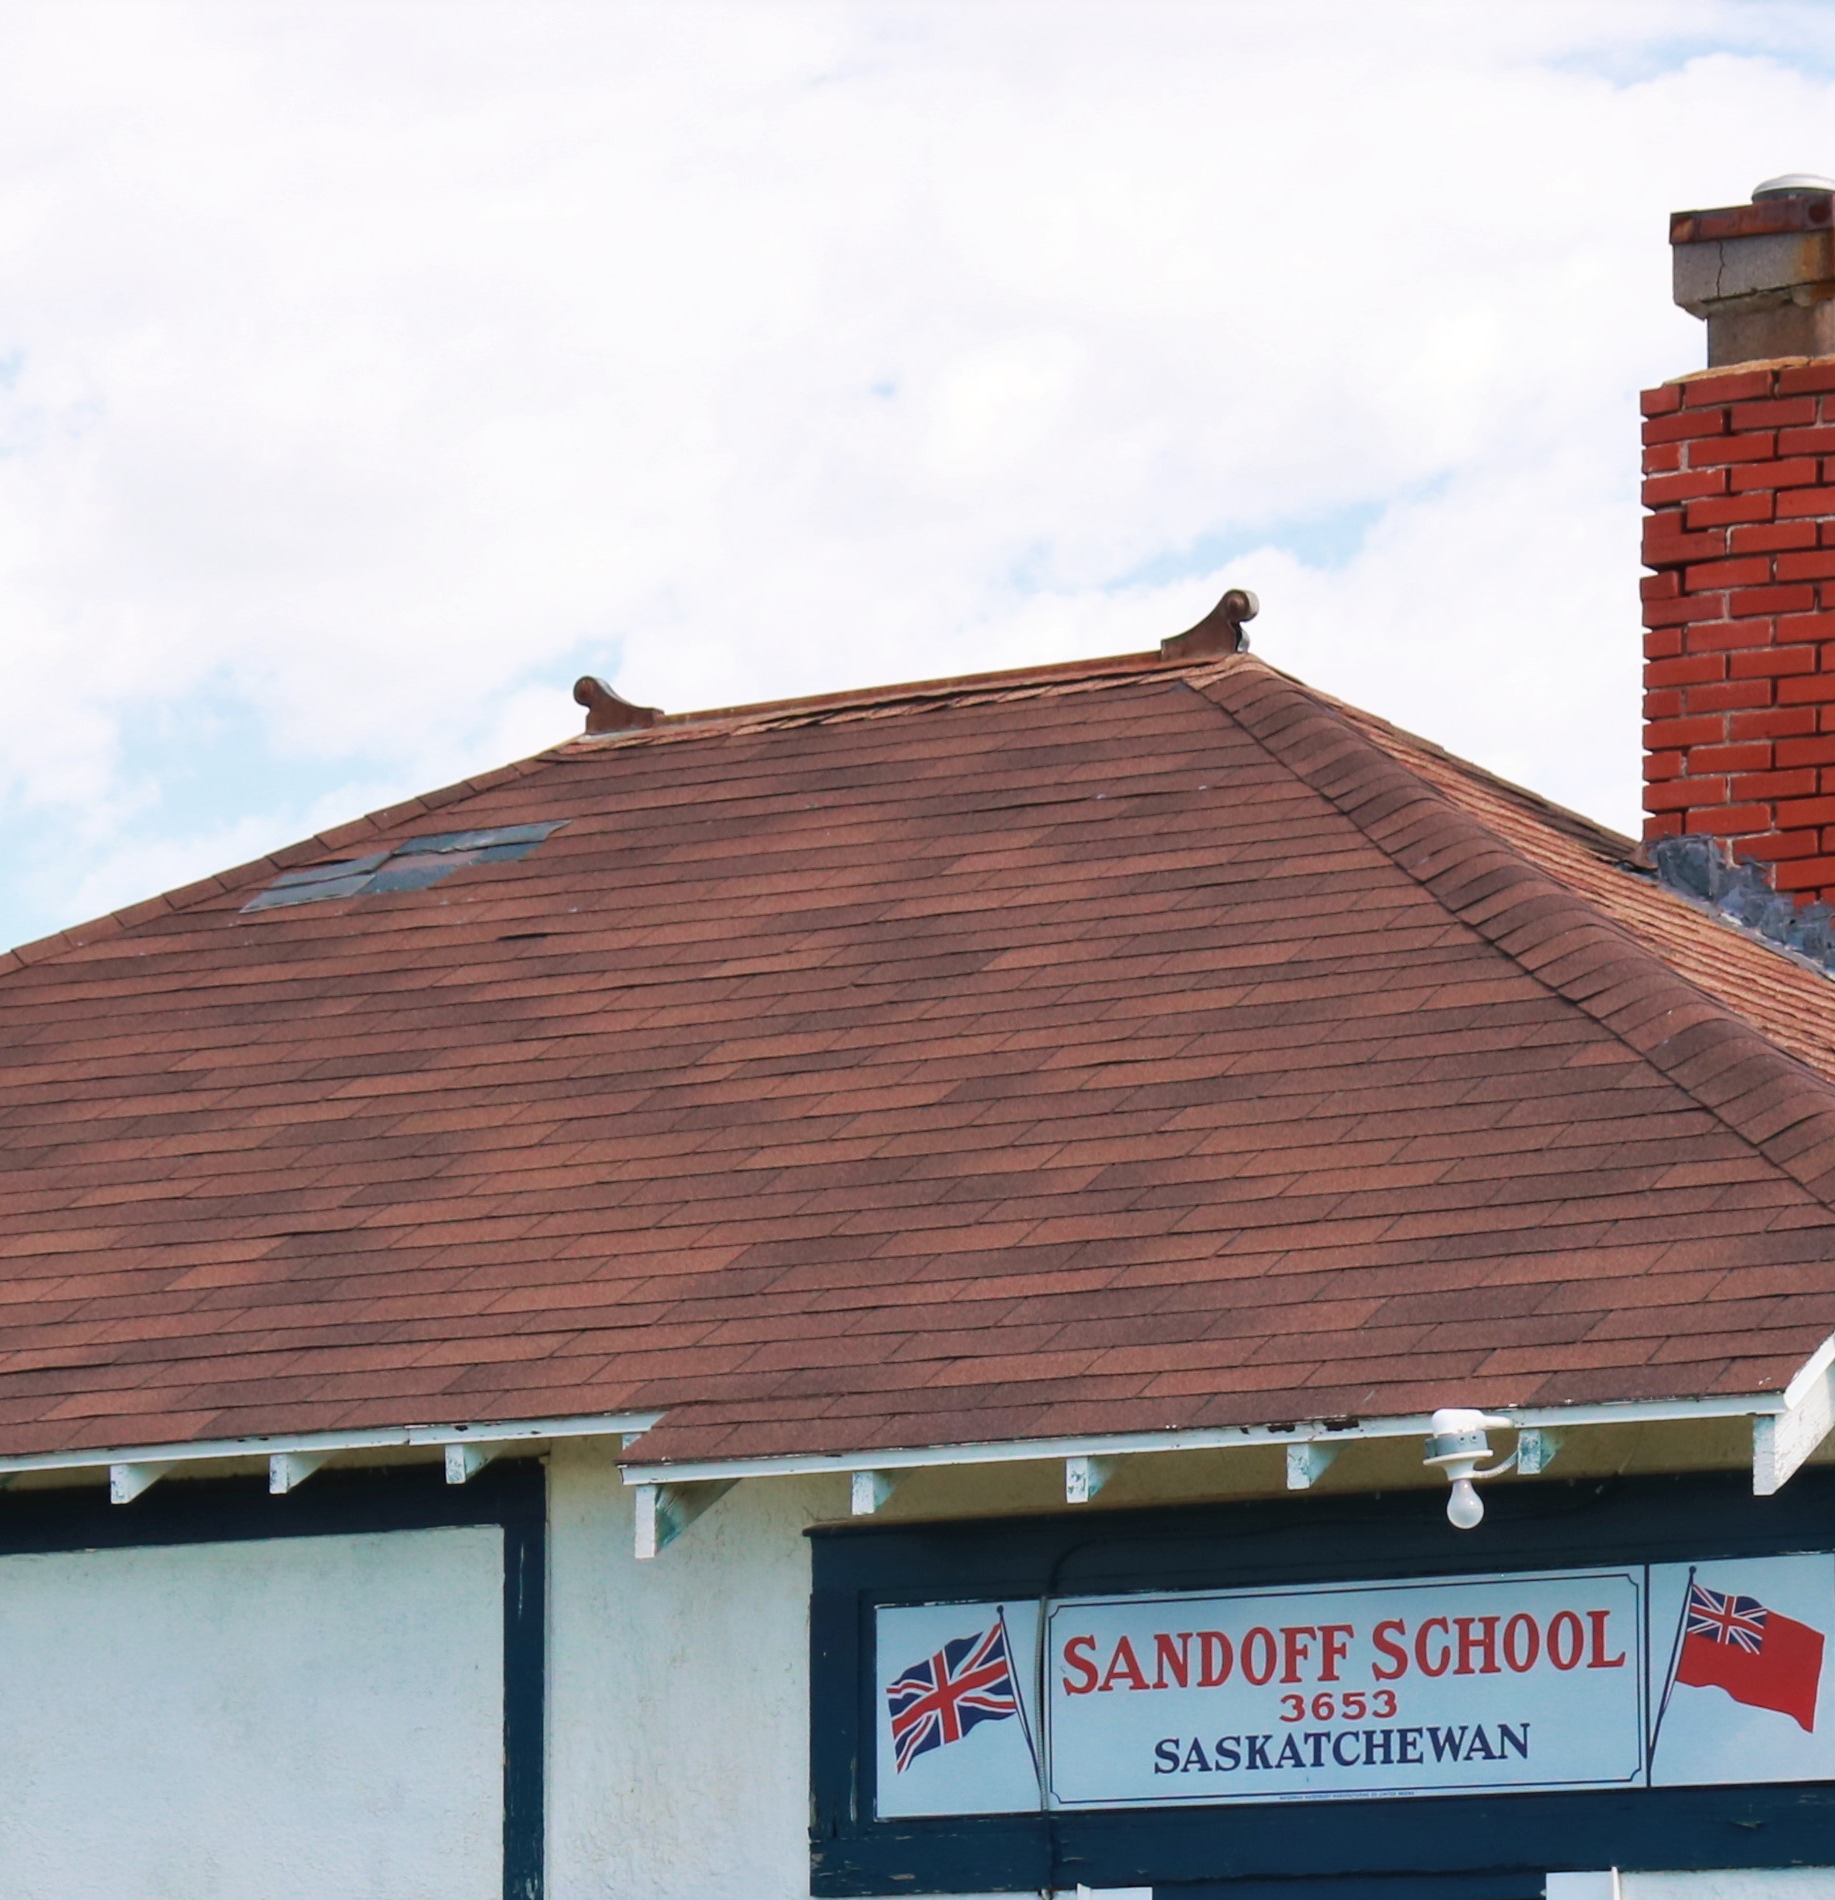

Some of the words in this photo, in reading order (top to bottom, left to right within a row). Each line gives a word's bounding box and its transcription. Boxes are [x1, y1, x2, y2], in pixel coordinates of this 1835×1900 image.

[1063, 1624, 1354, 1696] SANDOFF
[1374, 1610, 1624, 1678] SCHOOL
[1279, 1690, 1397, 1722] 3653
[1155, 1723, 1529, 1774] SASKATCHEWAN
